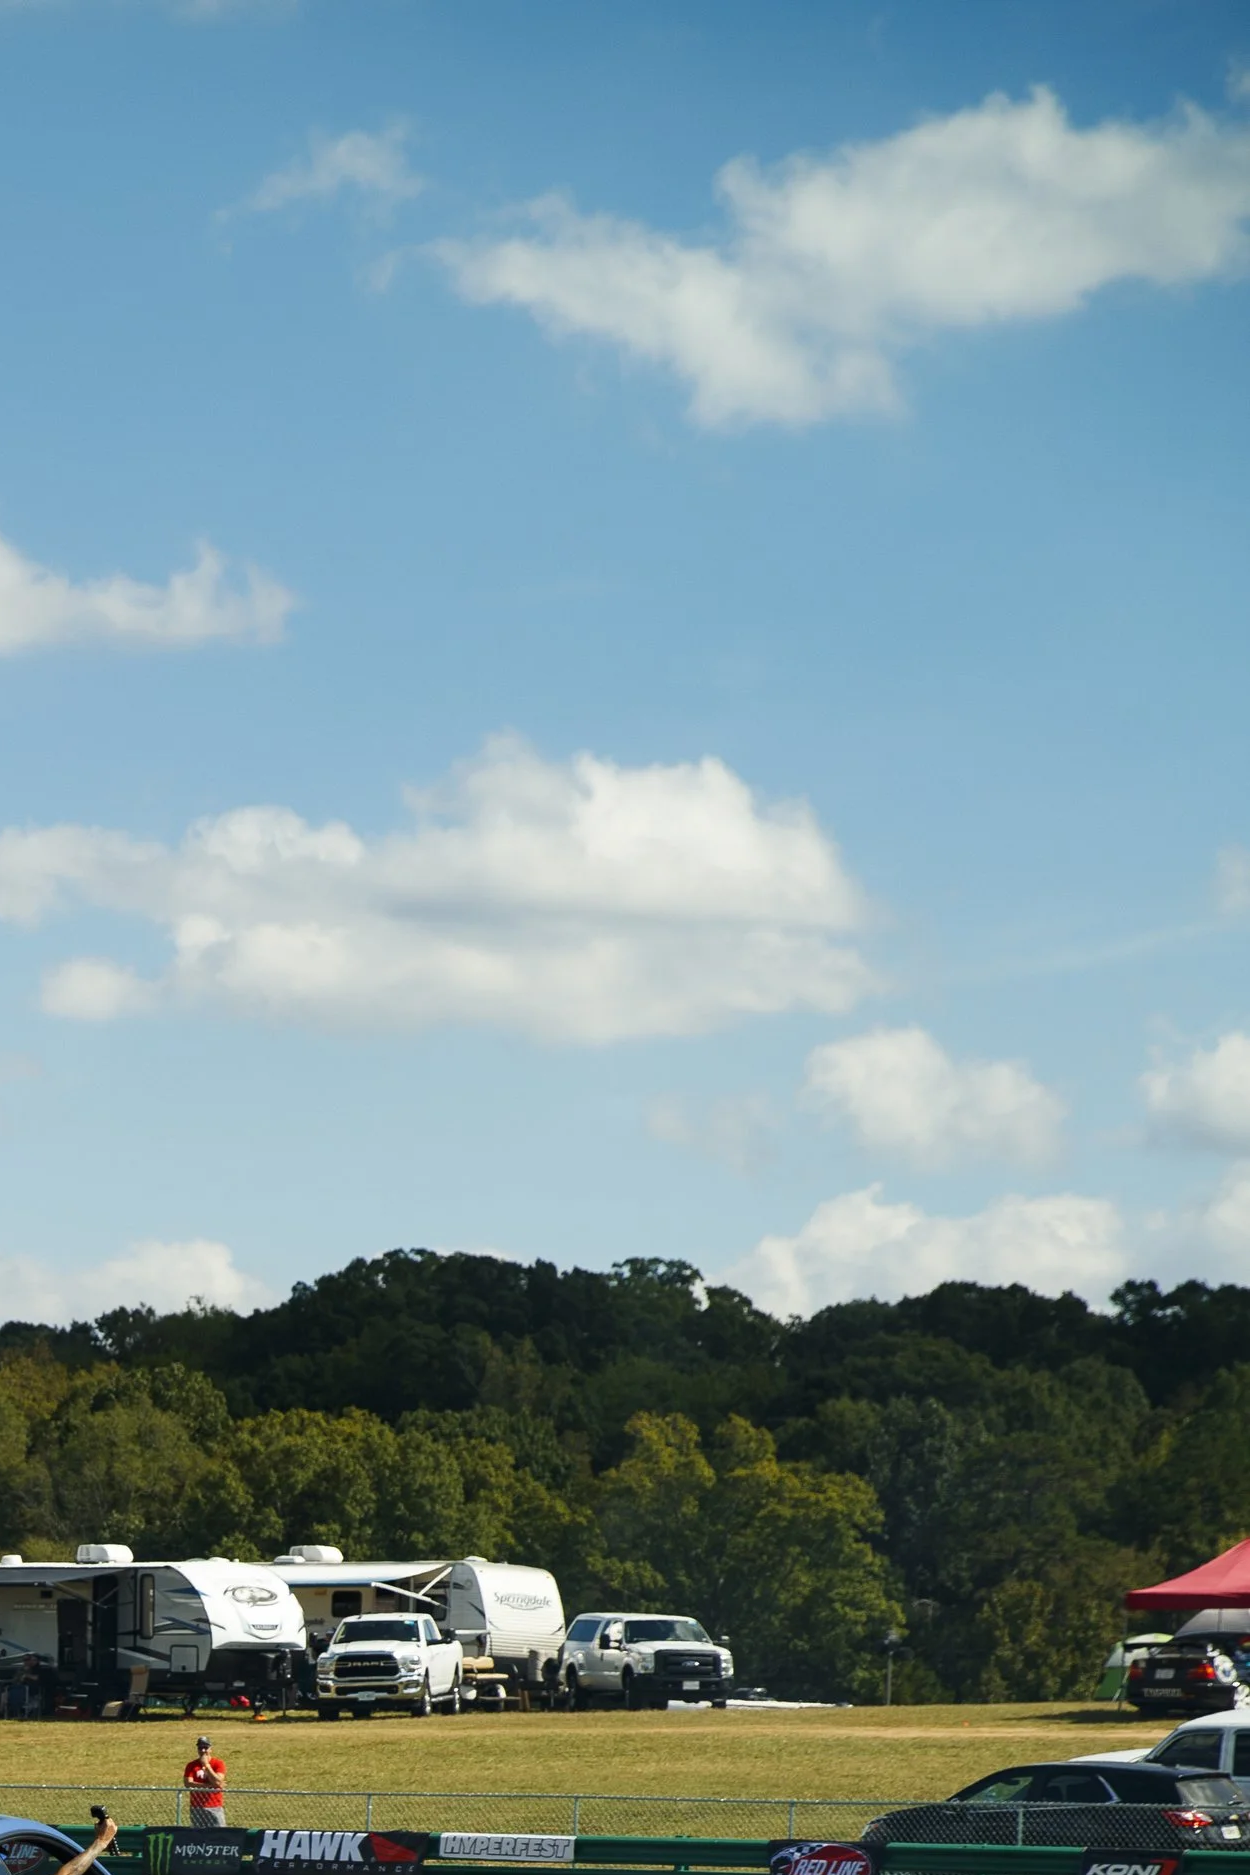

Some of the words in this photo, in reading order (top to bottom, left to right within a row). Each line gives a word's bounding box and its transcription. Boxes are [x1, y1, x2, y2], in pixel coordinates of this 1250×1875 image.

[494, 1592, 551, 1608] Springdale
[174, 1842, 240, 1857] MONSTER
[259, 1830, 369, 1862] HAWK
[444, 1836, 570, 1858] HYPERFEST
[257, 1859, 415, 1872] PERFORMANCE
